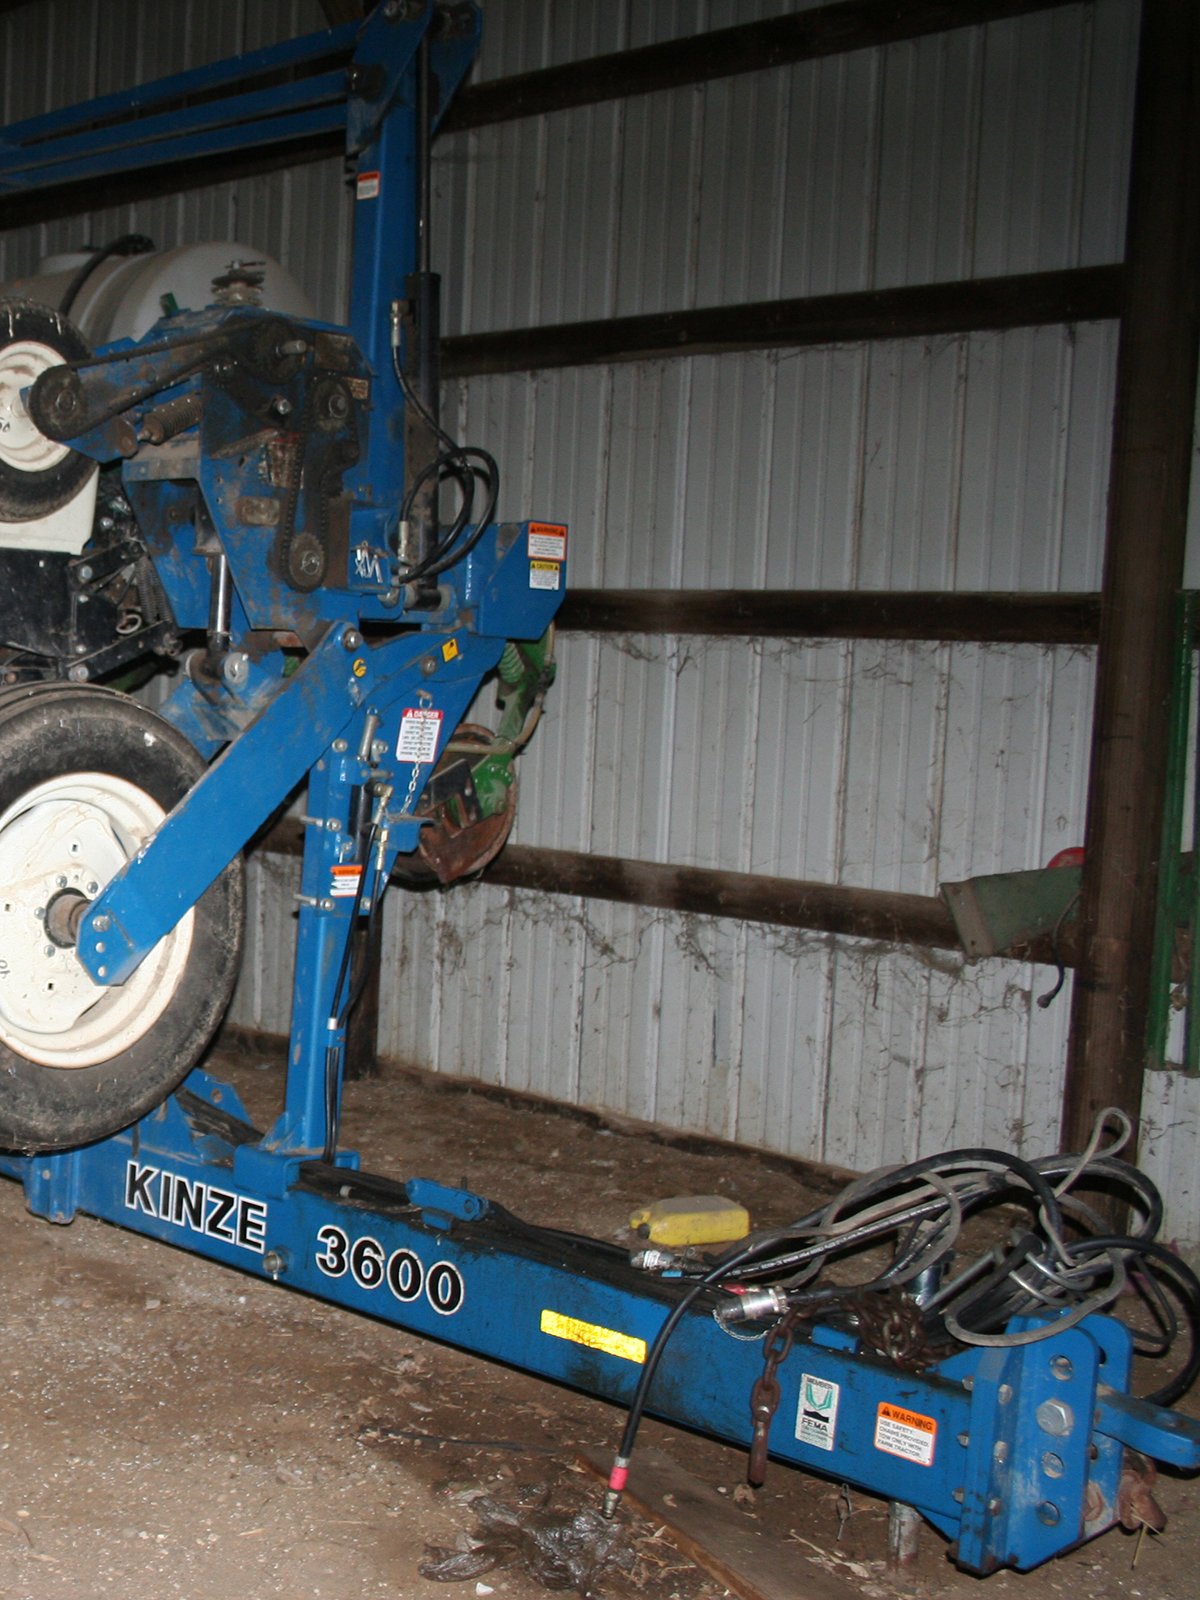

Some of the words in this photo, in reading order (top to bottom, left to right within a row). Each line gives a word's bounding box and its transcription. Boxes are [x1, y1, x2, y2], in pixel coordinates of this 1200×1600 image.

[124, 1159, 268, 1254] KINZE
[315, 1224, 465, 1316] 3600
[801, 1417, 828, 1433] FEMA
[892, 1410, 933, 1431] WARNING
